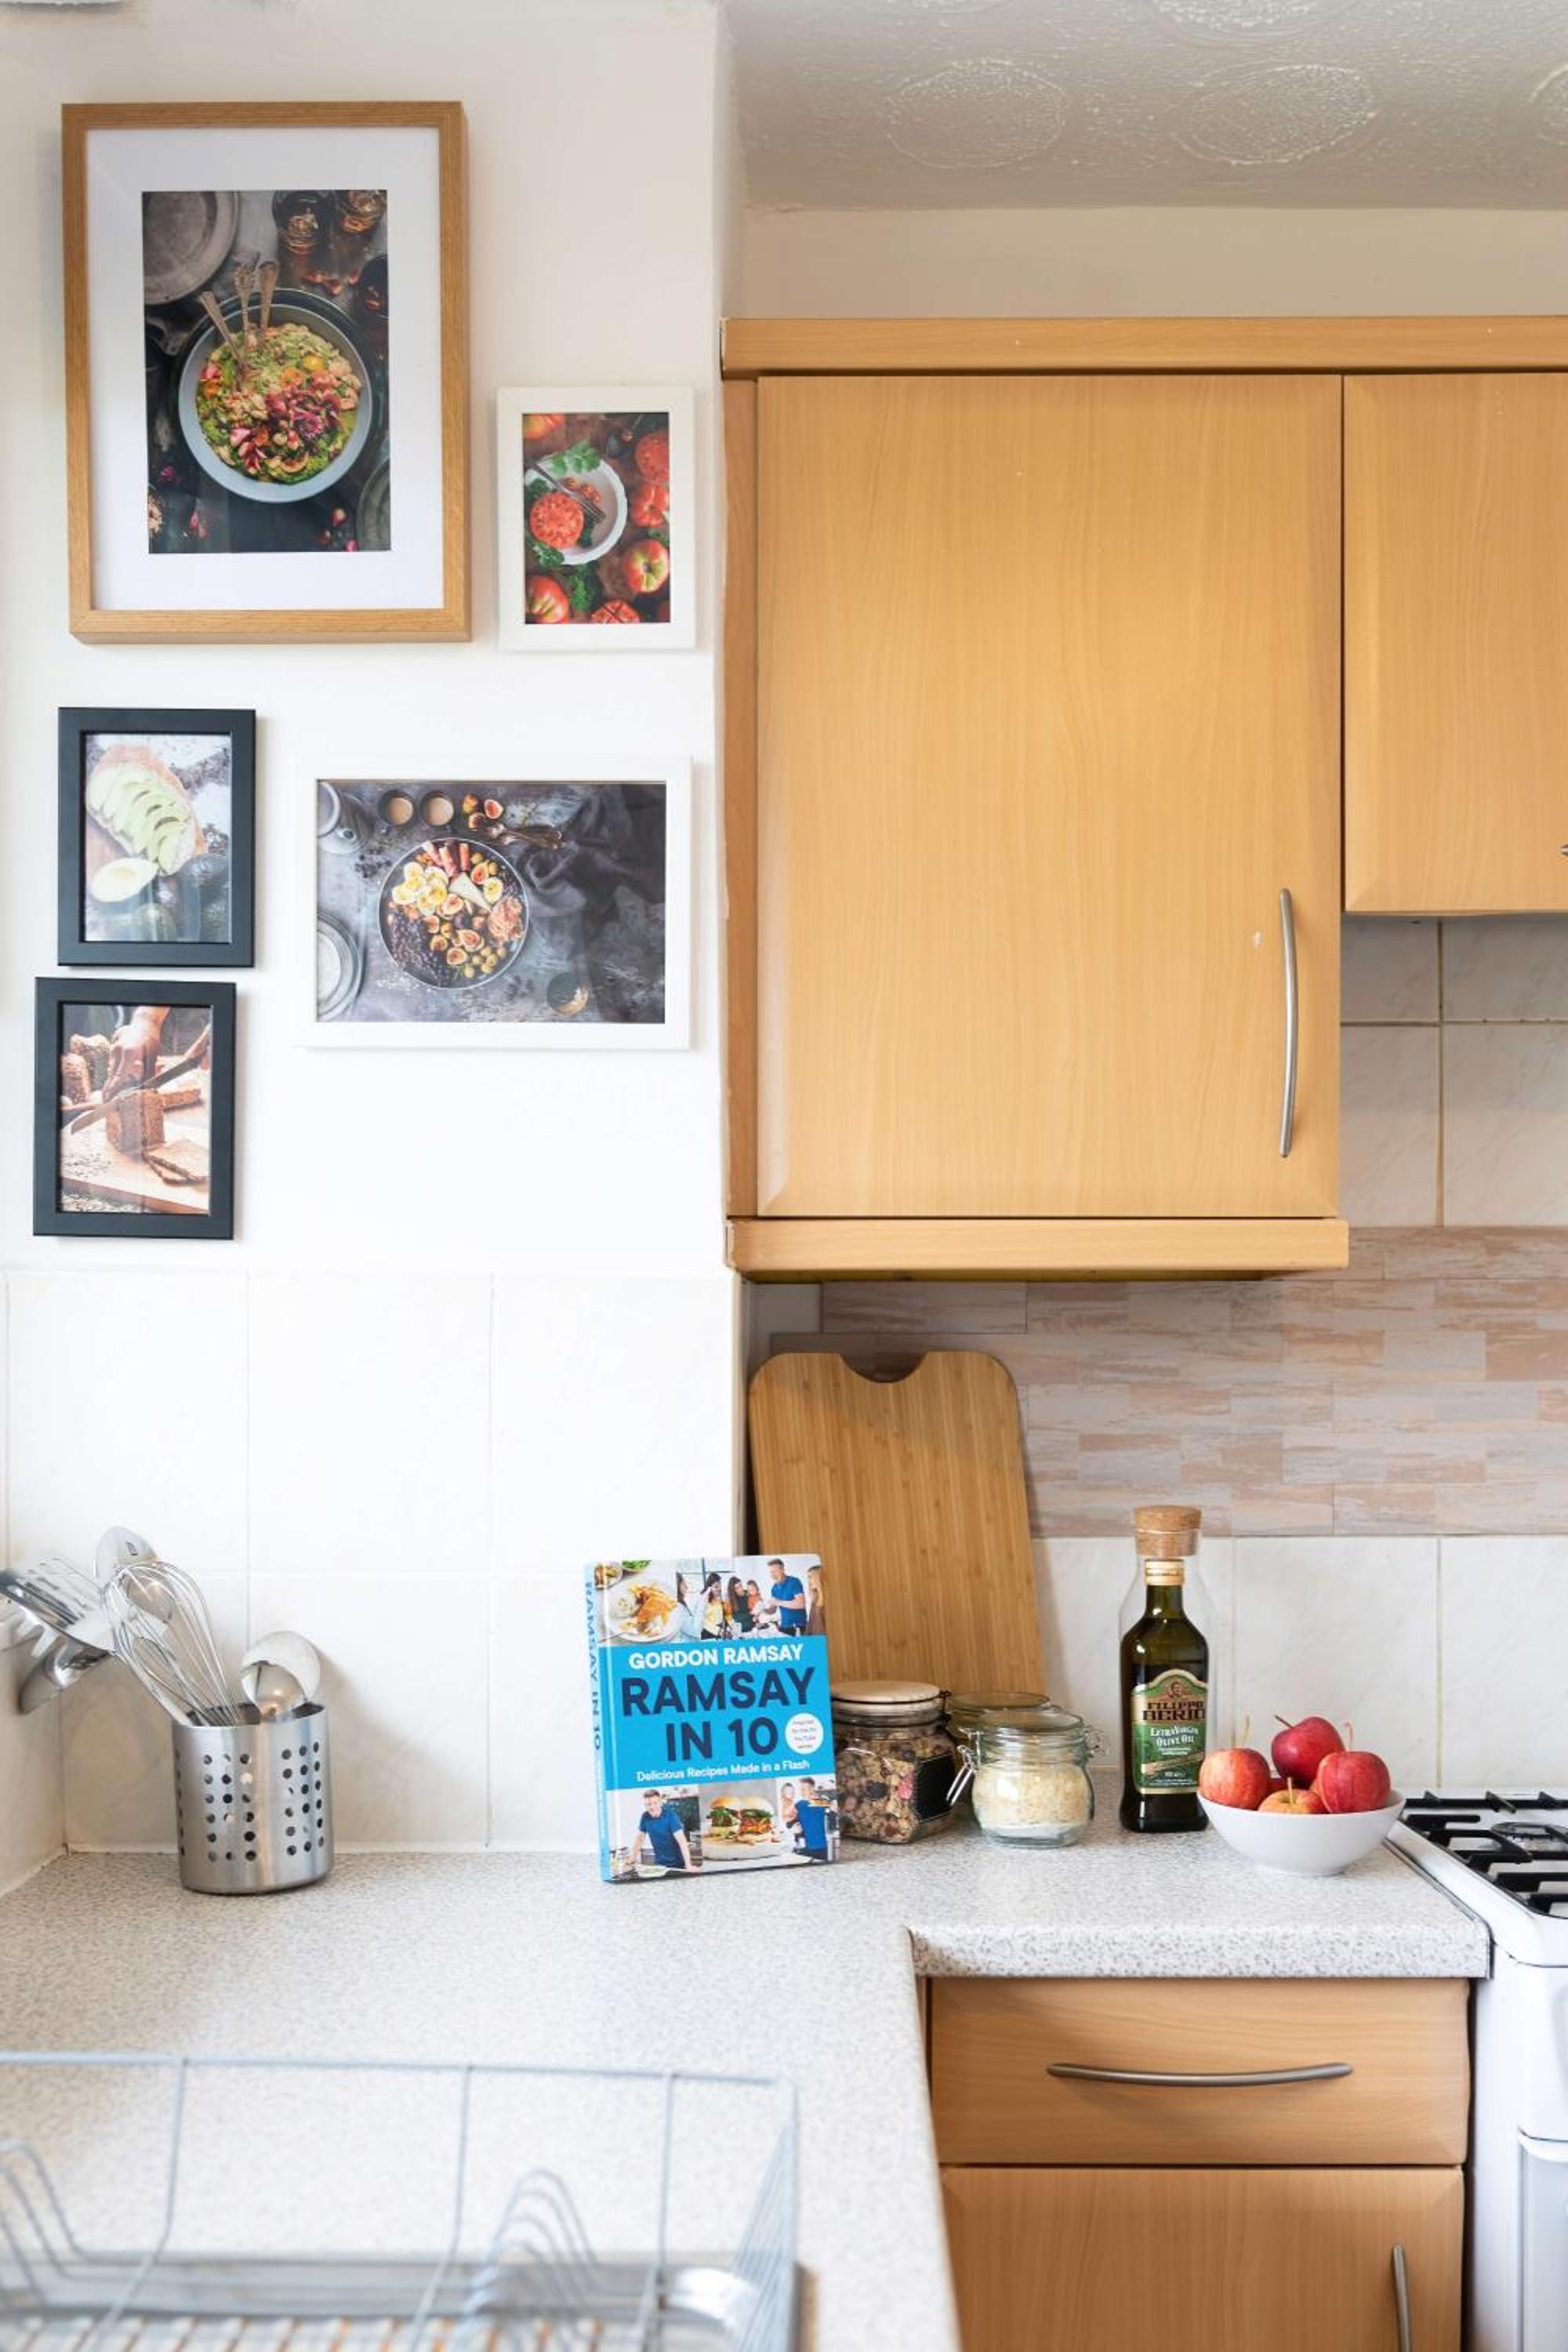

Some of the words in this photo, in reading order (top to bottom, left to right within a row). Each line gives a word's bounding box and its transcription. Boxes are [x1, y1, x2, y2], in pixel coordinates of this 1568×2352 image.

[585, 1582, 598, 1682] RAMSAY
[629, 1649, 718, 1668] GORDON
[724, 1644, 804, 1664] RAMSAY
[591, 1692, 600, 1715] IN
[621, 1667, 815, 1717] RAMSAY
[593, 1727, 601, 1751] 10
[665, 1721, 713, 1762] IN
[728, 1716, 779, 1757] 10
[637, 1770, 684, 1782] Delicious
[688, 1766, 728, 1778] Recipes
[730, 1763, 760, 1775] Made
[762, 1763, 771, 1772] in
[782, 1759, 811, 1769] Flash
